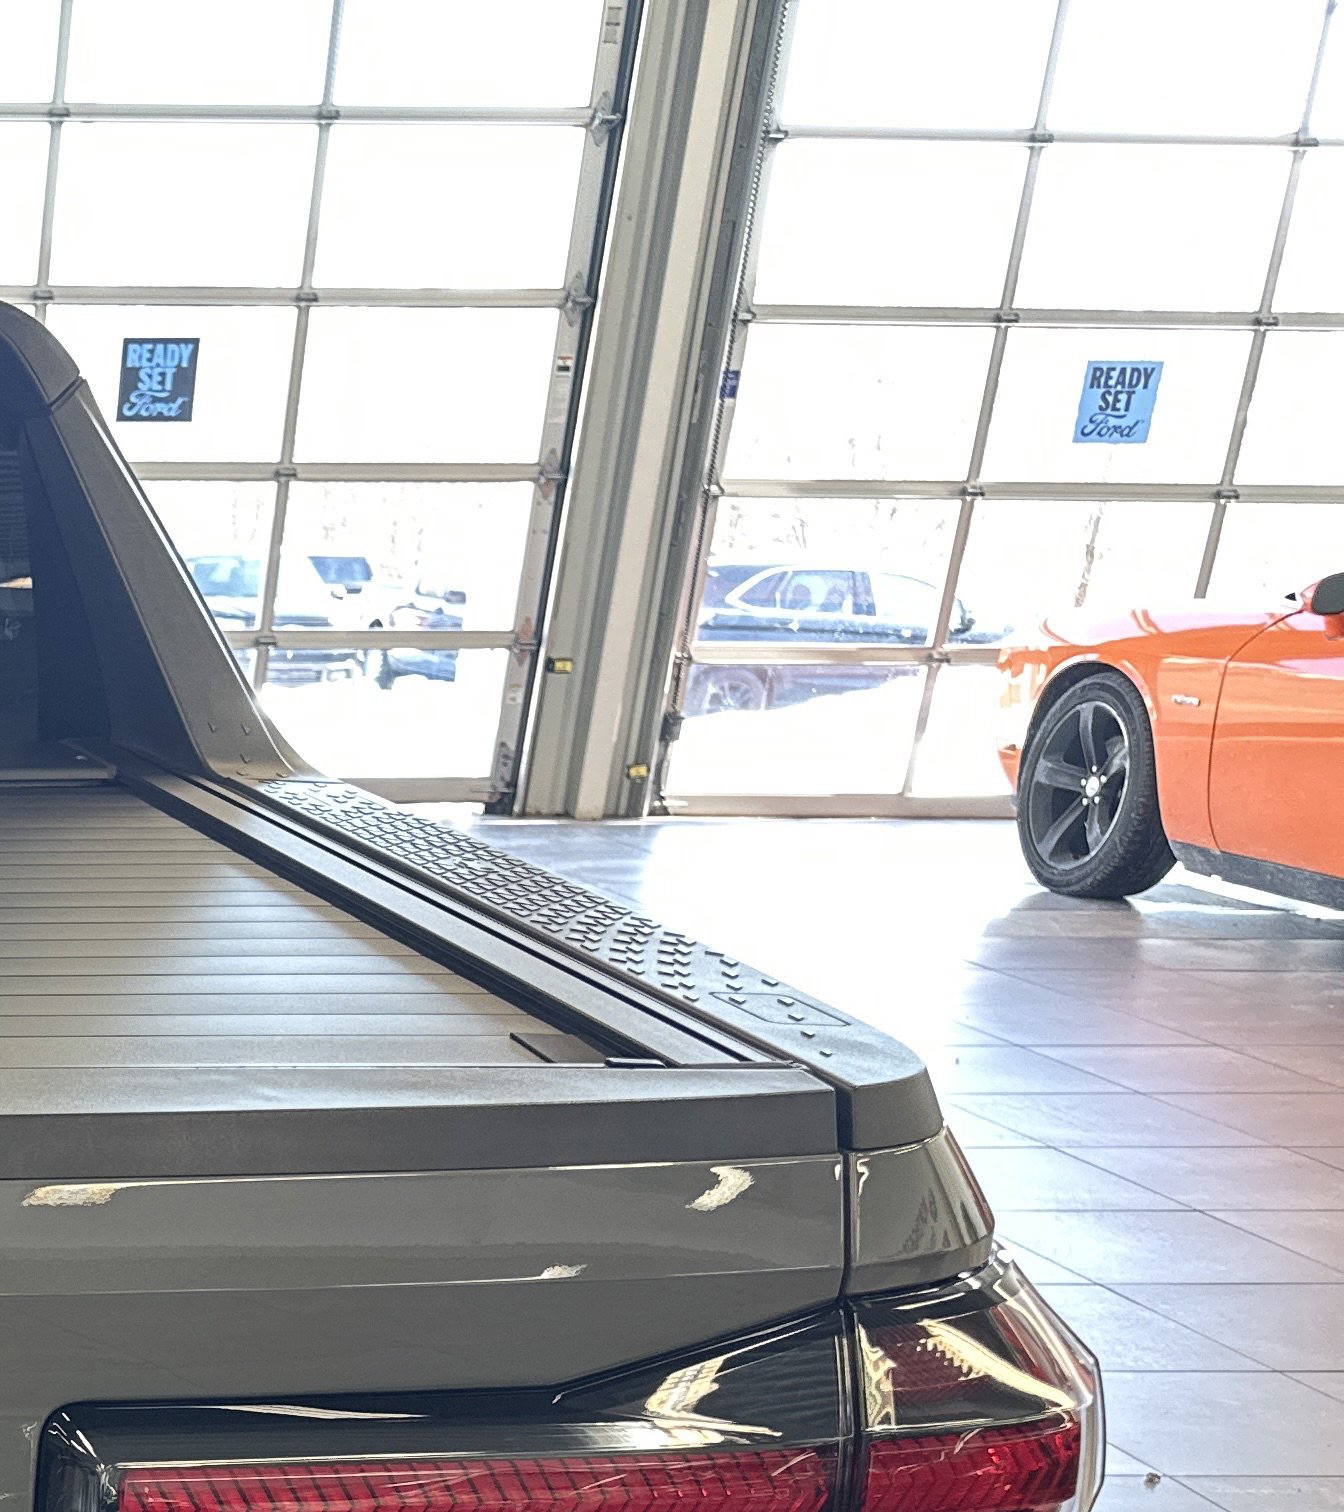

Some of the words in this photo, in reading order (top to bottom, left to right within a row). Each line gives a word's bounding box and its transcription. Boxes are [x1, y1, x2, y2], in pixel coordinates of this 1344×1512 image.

[126, 343, 194, 368] READY
[137, 367, 177, 391] SET
[1089, 366, 1156, 390] READY
[122, 391, 189, 417] Ford
[1098, 390, 1136, 412] SET
[1080, 413, 1145, 438] Ford
